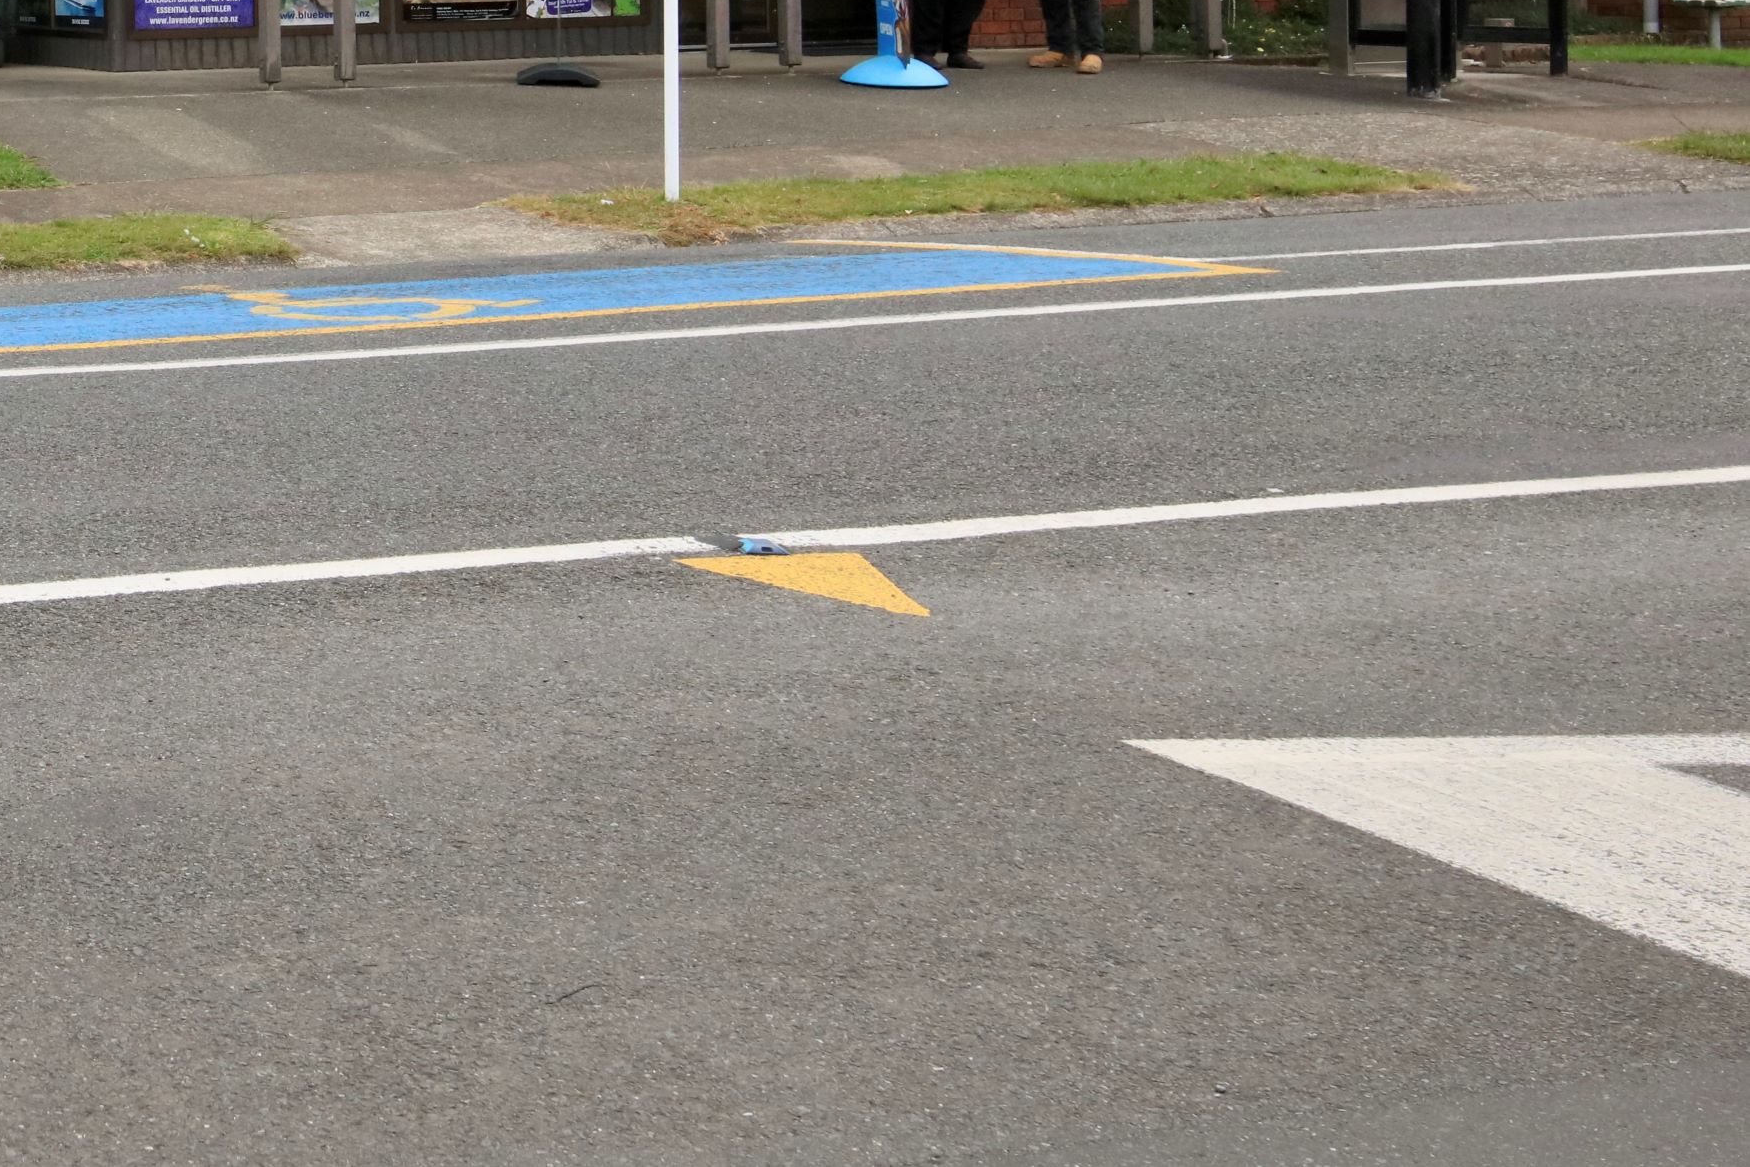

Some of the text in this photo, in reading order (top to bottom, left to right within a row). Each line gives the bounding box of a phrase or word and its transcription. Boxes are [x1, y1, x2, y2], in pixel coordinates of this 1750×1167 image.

[156, 6, 188, 14] ESSENTIAL
[201, 5, 231, 13] DISTILLER
[149, 15, 238, 25] www.lavendergreen.co.nz
